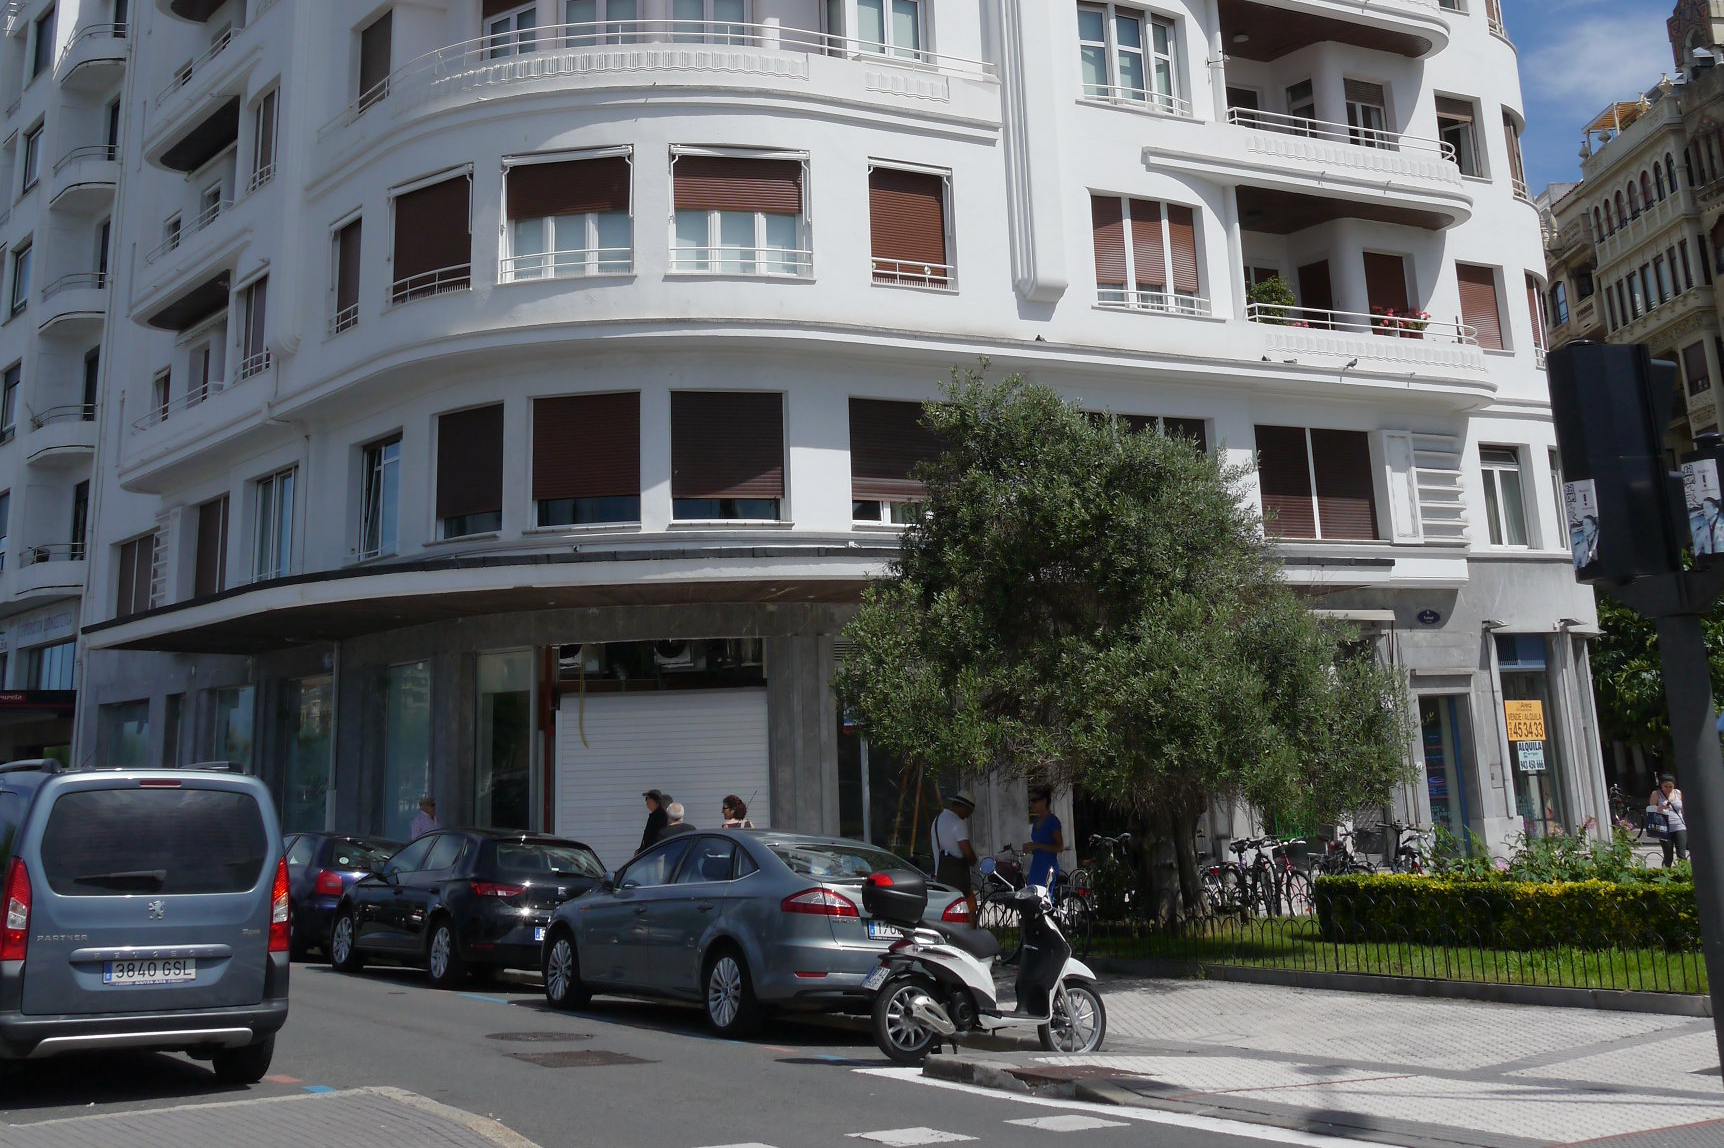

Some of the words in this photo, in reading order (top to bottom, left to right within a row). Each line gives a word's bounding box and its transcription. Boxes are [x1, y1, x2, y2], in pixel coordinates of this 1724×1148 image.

[1508, 713, 1522, 721] VENDE
[1524, 712, 1541, 720] ALQUILA
[1513, 722, 1523, 738] 45
[1523, 722, 1533, 738] 34
[1534, 722, 1544, 738] 33
[1518, 742, 1541, 752] ALQUILA
[1520, 760, 1528, 770] 943
[36, 934, 88, 942] PARTNER
[115, 961, 157, 978] 3840
[162, 960, 192, 977] GSL
